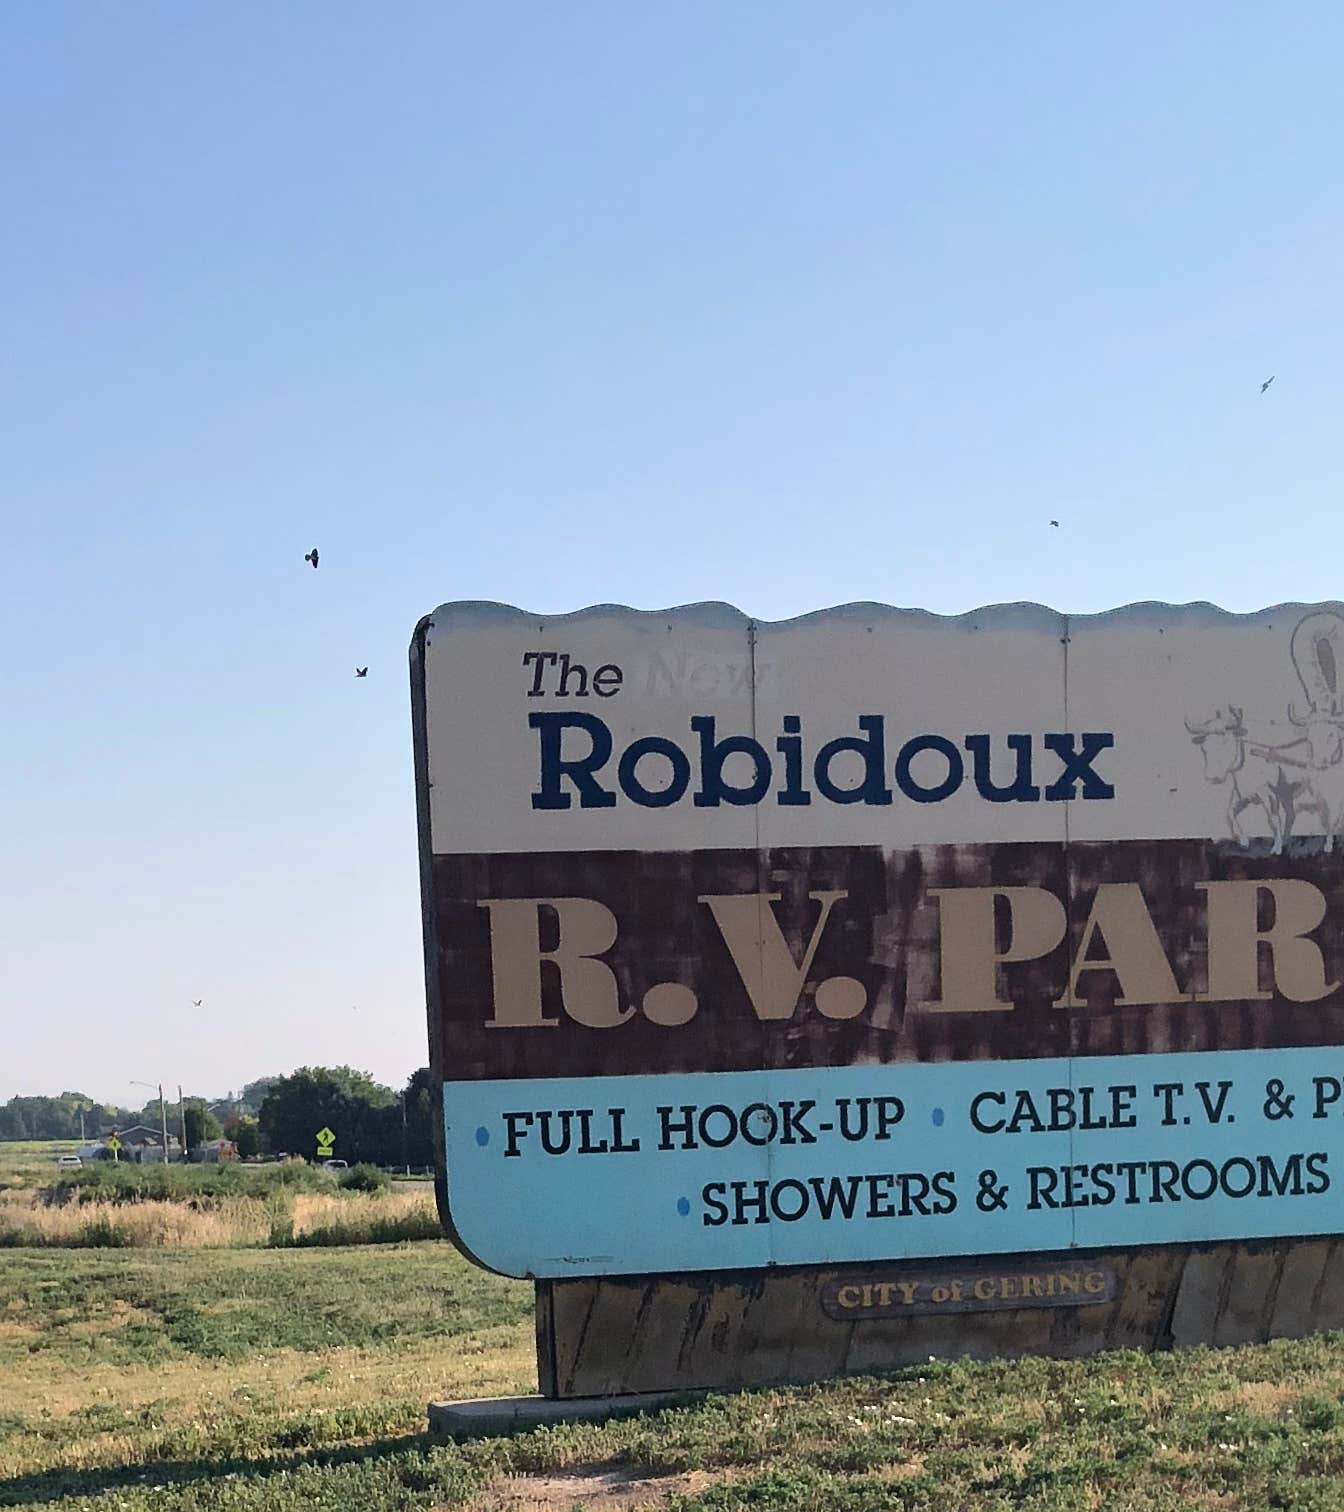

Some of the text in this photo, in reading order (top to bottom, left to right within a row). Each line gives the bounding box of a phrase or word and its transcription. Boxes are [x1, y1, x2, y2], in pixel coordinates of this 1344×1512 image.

[522, 651, 624, 698] The
[528, 711, 1115, 810] Robidoux
[502, 1108, 640, 1157] FULL
[656, 1095, 906, 1151] HOOK-UP
[969, 1084, 1137, 1134] CABLE
[1153, 1079, 1235, 1126] T.V.
[1263, 1078, 1295, 1121] &
[702, 1152, 1330, 1227] SHOWERS & RESTROOMS
[837, 1271, 1105, 1309] CITY of GERING
